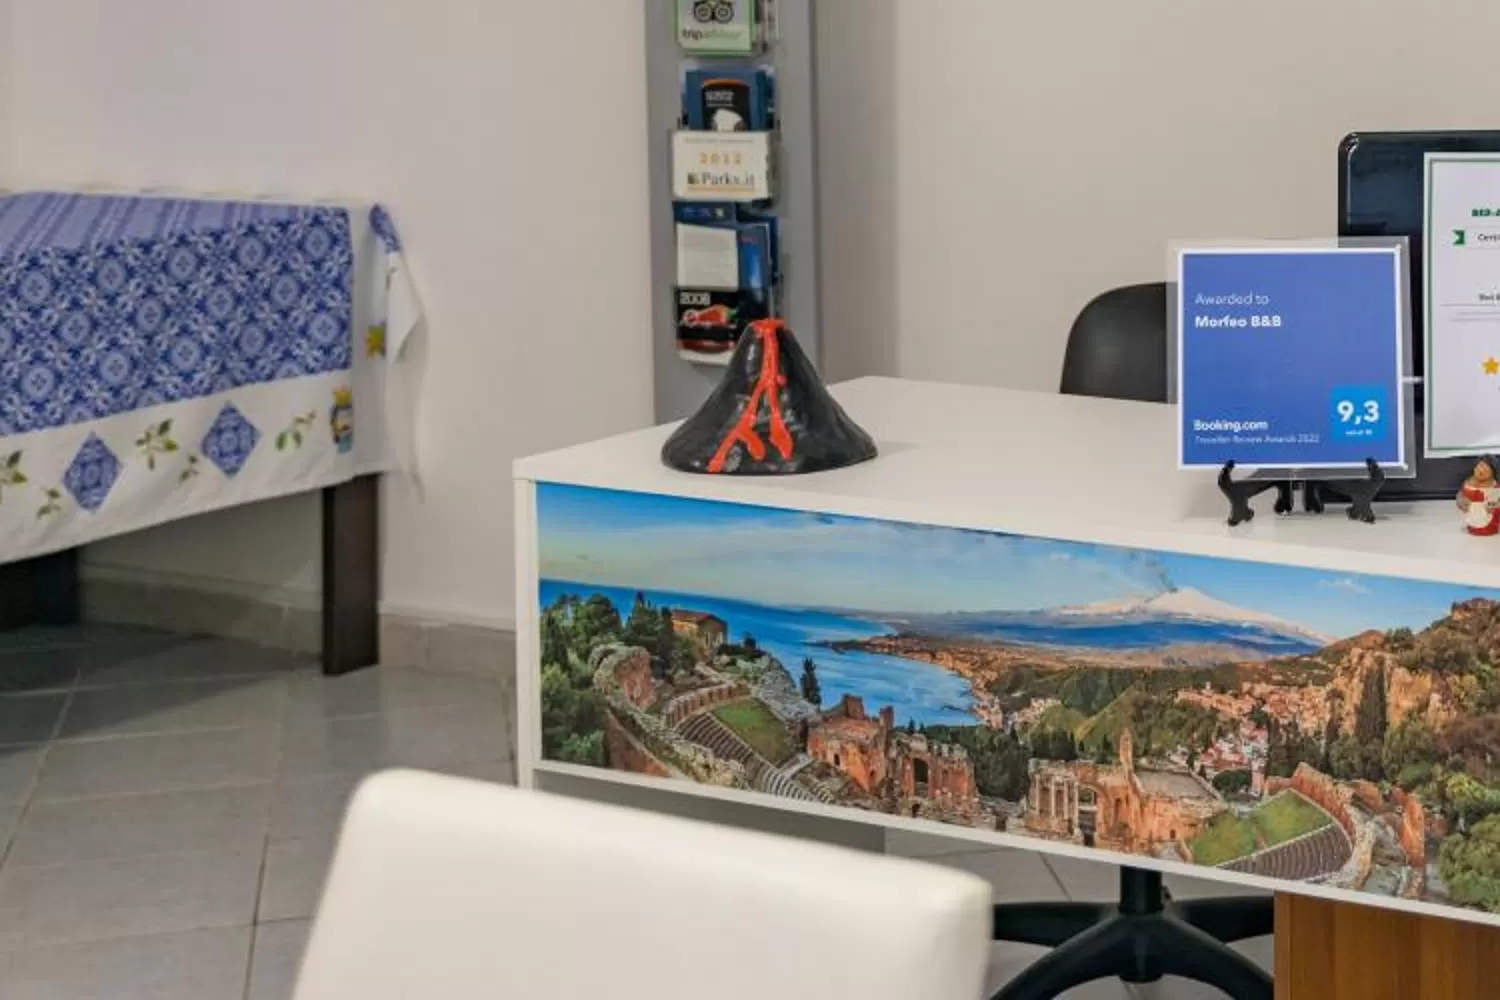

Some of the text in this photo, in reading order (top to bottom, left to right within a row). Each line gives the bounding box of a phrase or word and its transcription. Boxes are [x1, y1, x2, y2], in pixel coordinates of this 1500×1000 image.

[1194, 289, 1269, 305] Awarded to
[1195, 314, 1281, 328] Morfeo B&B
[1337, 400, 1380, 425] 9,3
[1193, 419, 1269, 433] Booking.com
